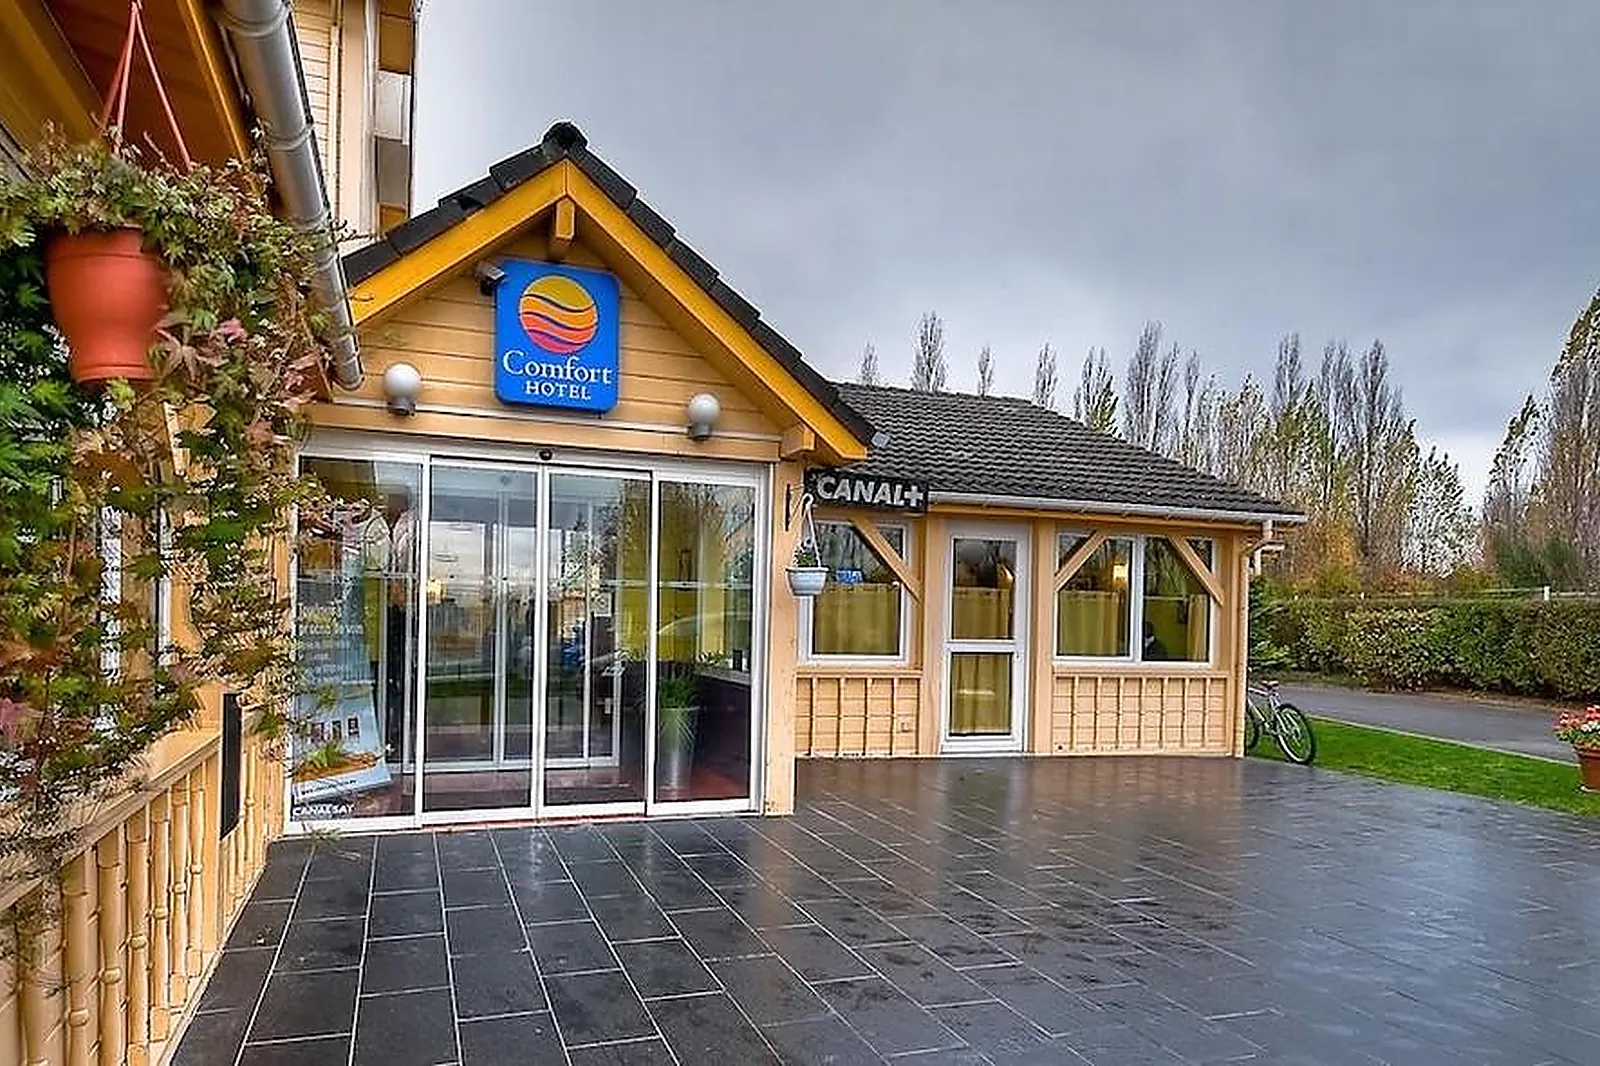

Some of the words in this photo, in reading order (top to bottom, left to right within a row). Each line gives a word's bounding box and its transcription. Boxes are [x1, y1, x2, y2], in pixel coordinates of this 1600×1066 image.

[503, 350, 612, 384] Comfort
[526, 381, 591, 400] HOTEL
[817, 475, 924, 507] CANAL+
